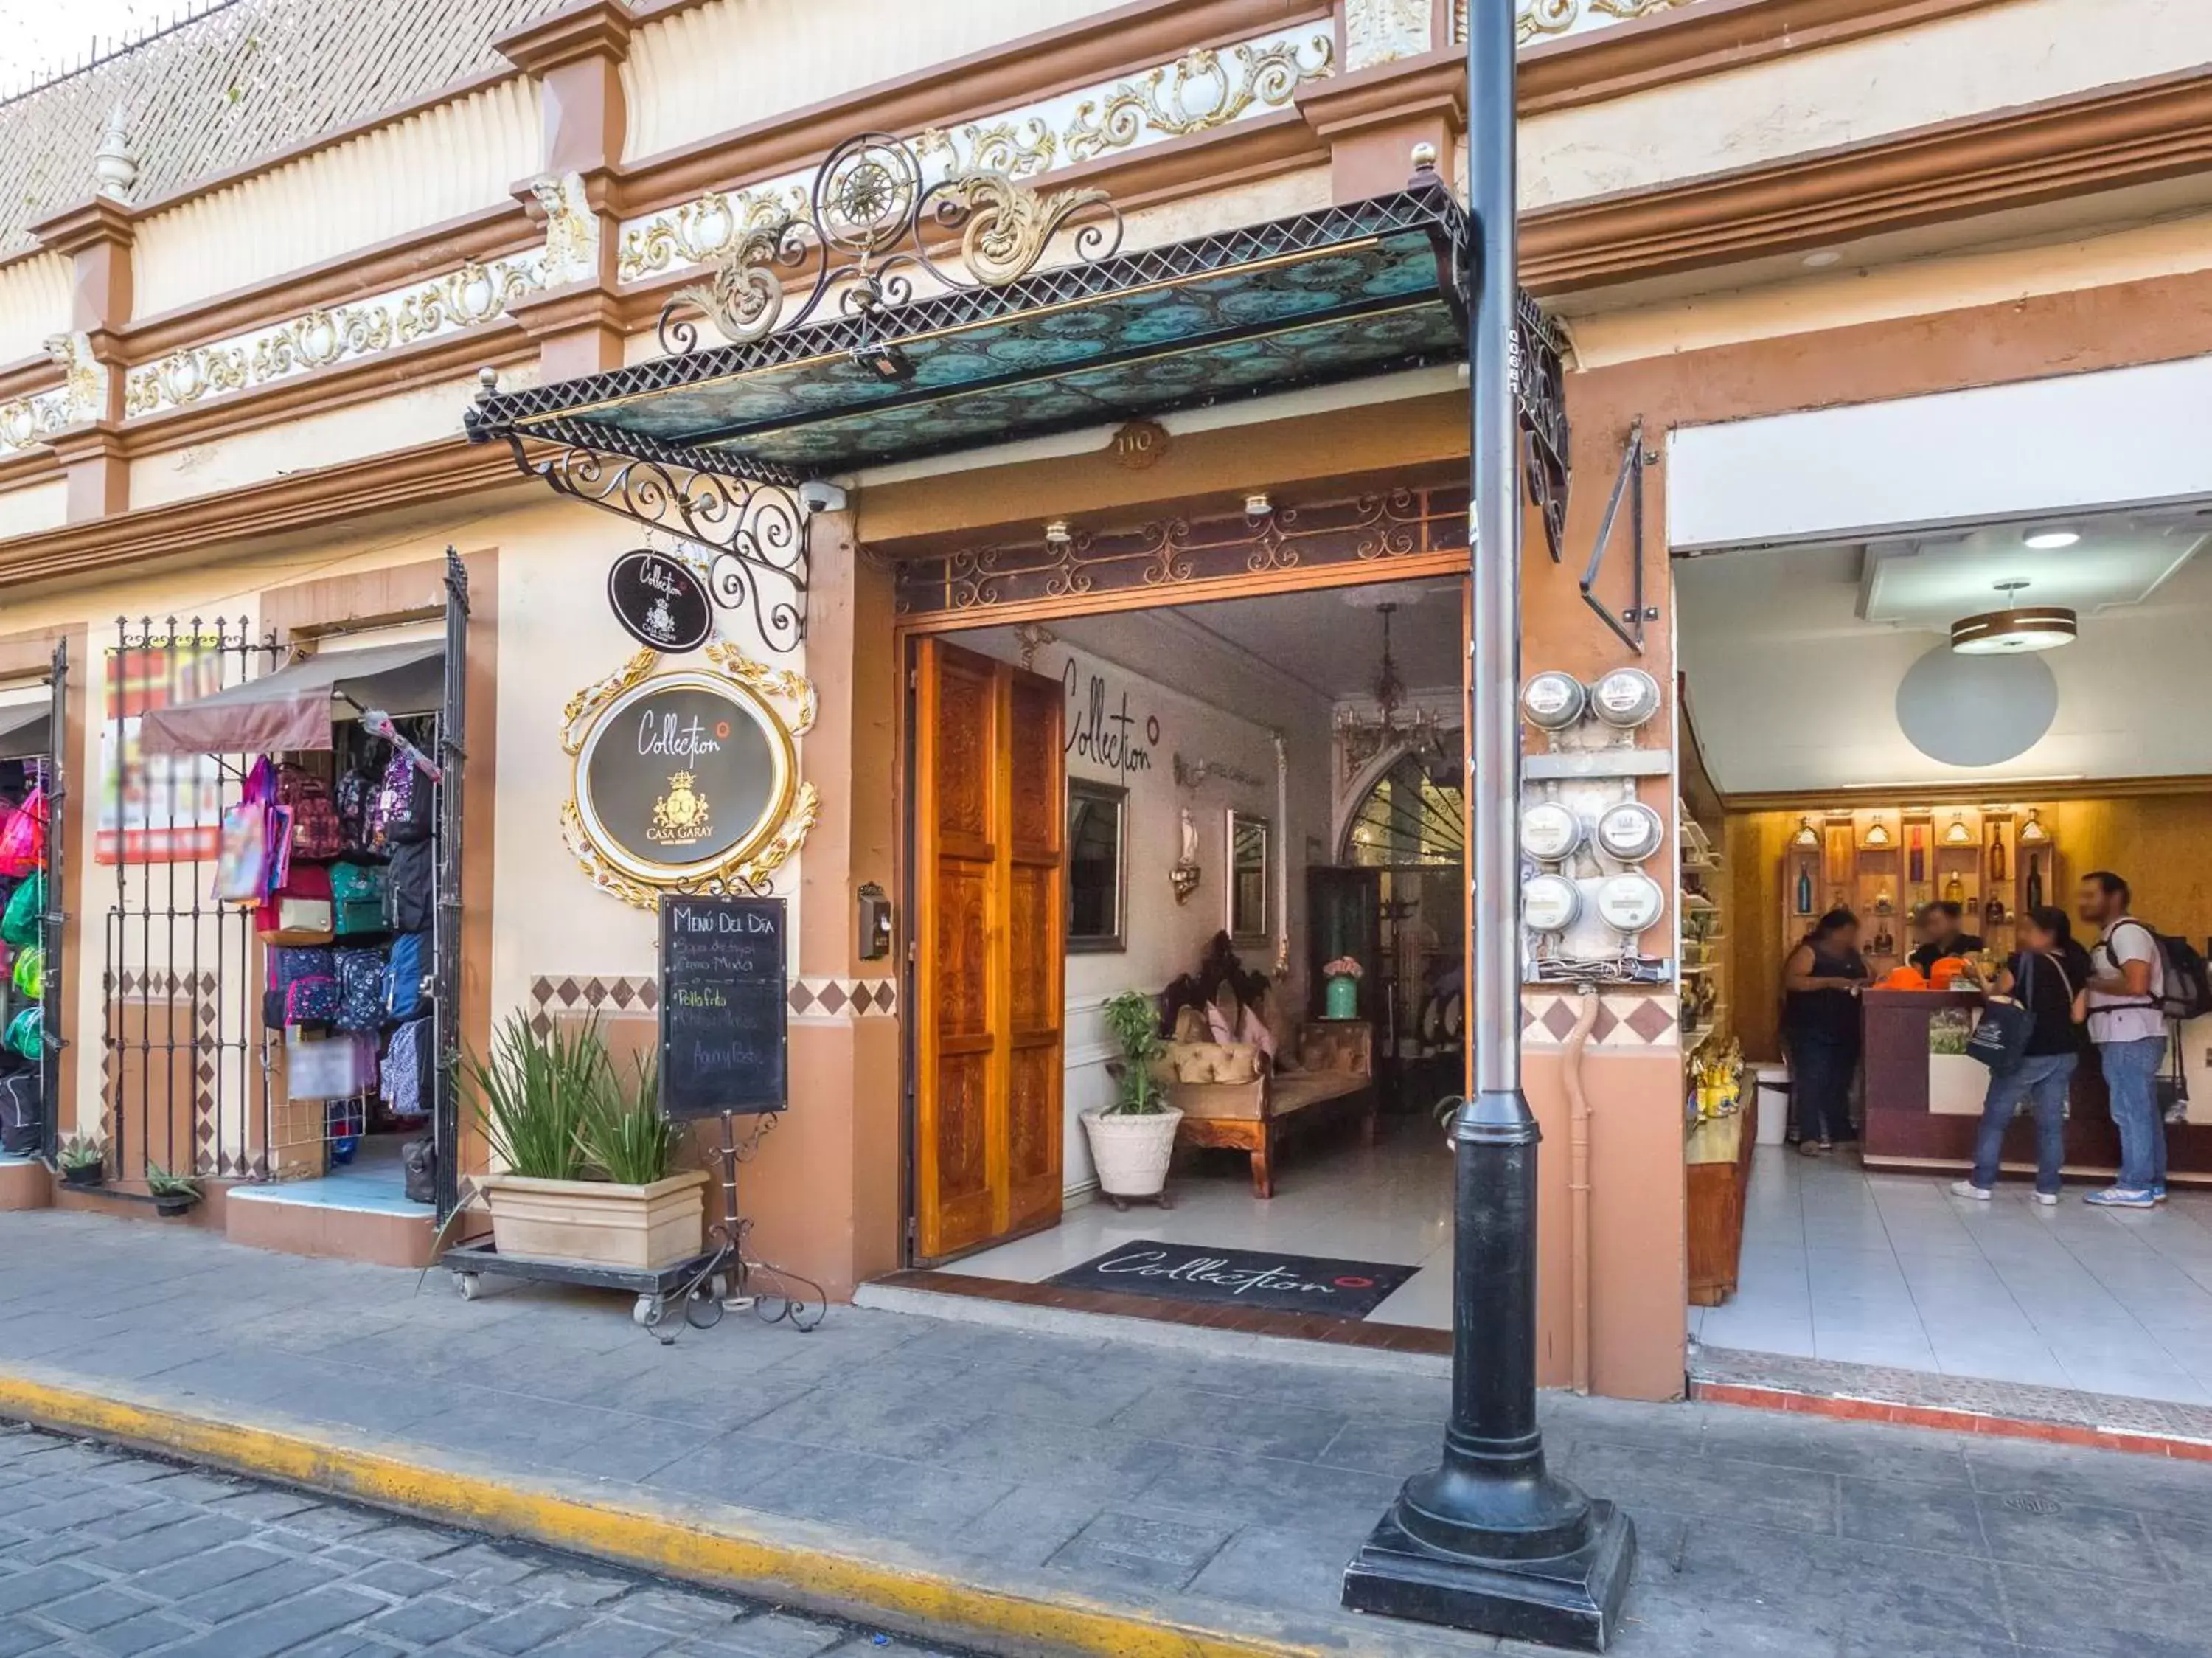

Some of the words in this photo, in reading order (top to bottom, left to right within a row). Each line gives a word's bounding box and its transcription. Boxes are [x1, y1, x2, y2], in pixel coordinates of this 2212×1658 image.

[1119, 430, 1152, 455] 110
[638, 710, 720, 769] Collection
[1062, 658, 1151, 786] Collection
[1097, 1251, 1335, 1294] Collection
